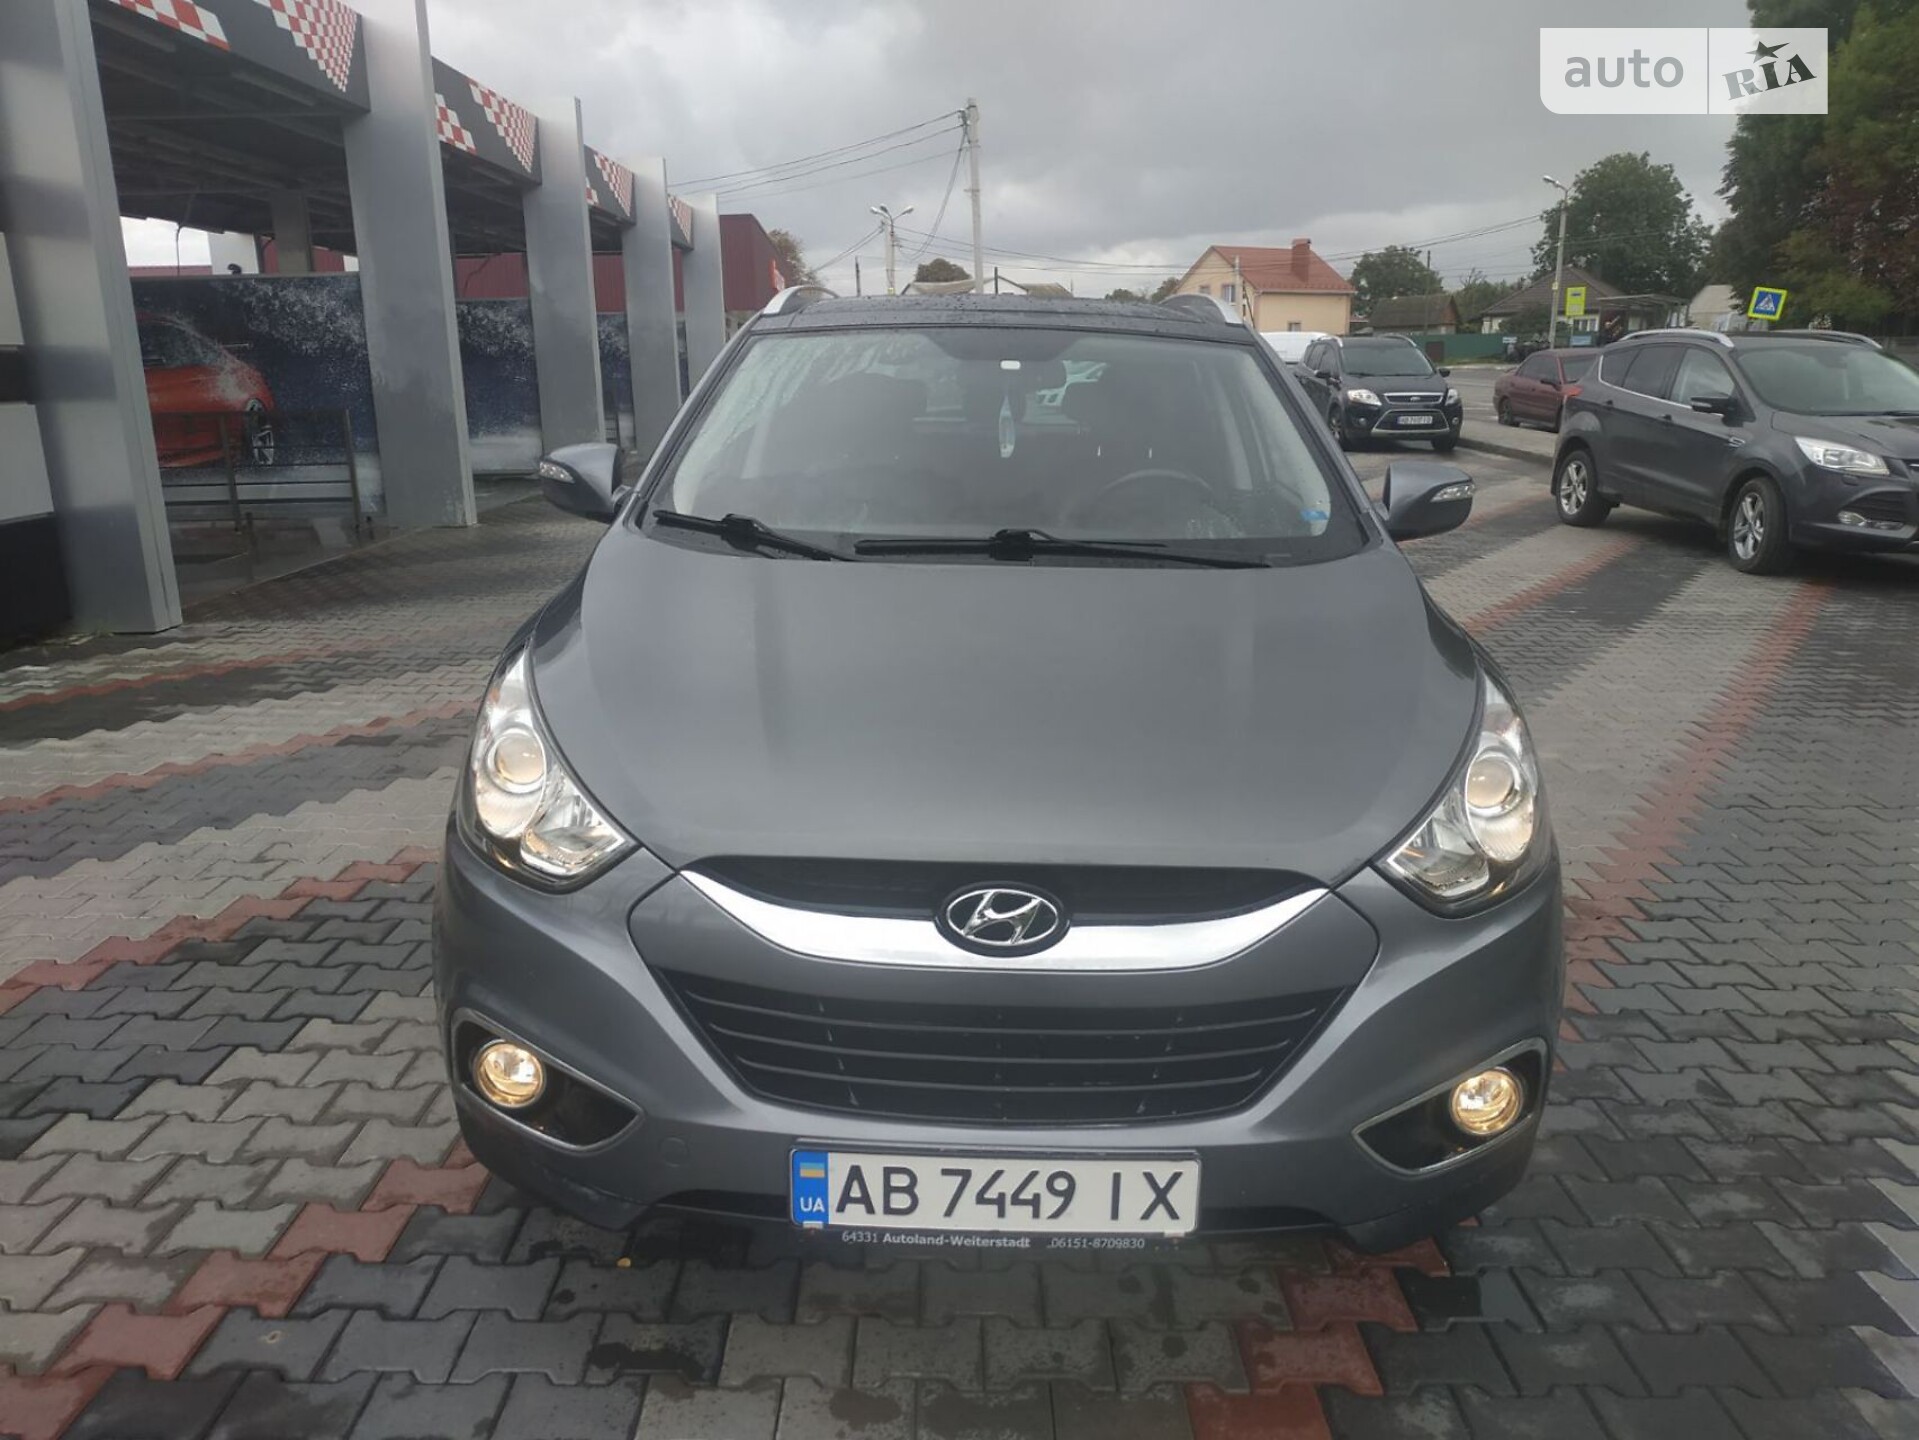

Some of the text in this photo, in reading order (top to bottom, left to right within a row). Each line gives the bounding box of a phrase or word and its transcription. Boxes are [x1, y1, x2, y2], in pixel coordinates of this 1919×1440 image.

[835, 1164, 1184, 1221] AB 7449 IX
[800, 1196, 826, 1212] UA
[841, 1229, 878, 1243] 64331
[882, 1232, 1031, 1249] Autoland-Weiterstadt
